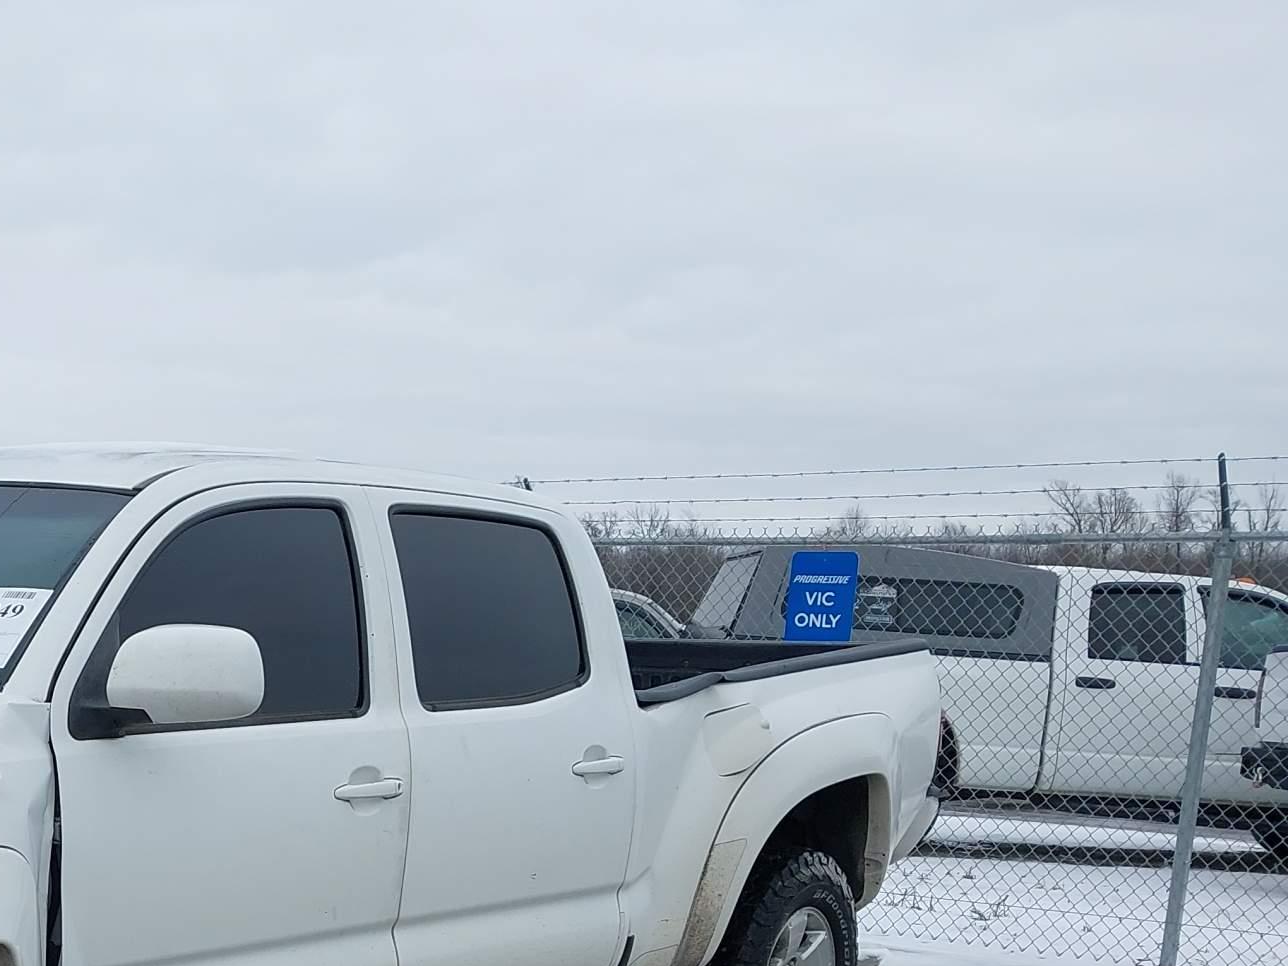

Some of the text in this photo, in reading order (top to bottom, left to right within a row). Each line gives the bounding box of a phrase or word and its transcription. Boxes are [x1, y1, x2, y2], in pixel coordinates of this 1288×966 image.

[793, 574, 852, 585] PROGRESSIVE
[805, 591, 836, 607] VIC
[794, 612, 842, 629] ONLY
